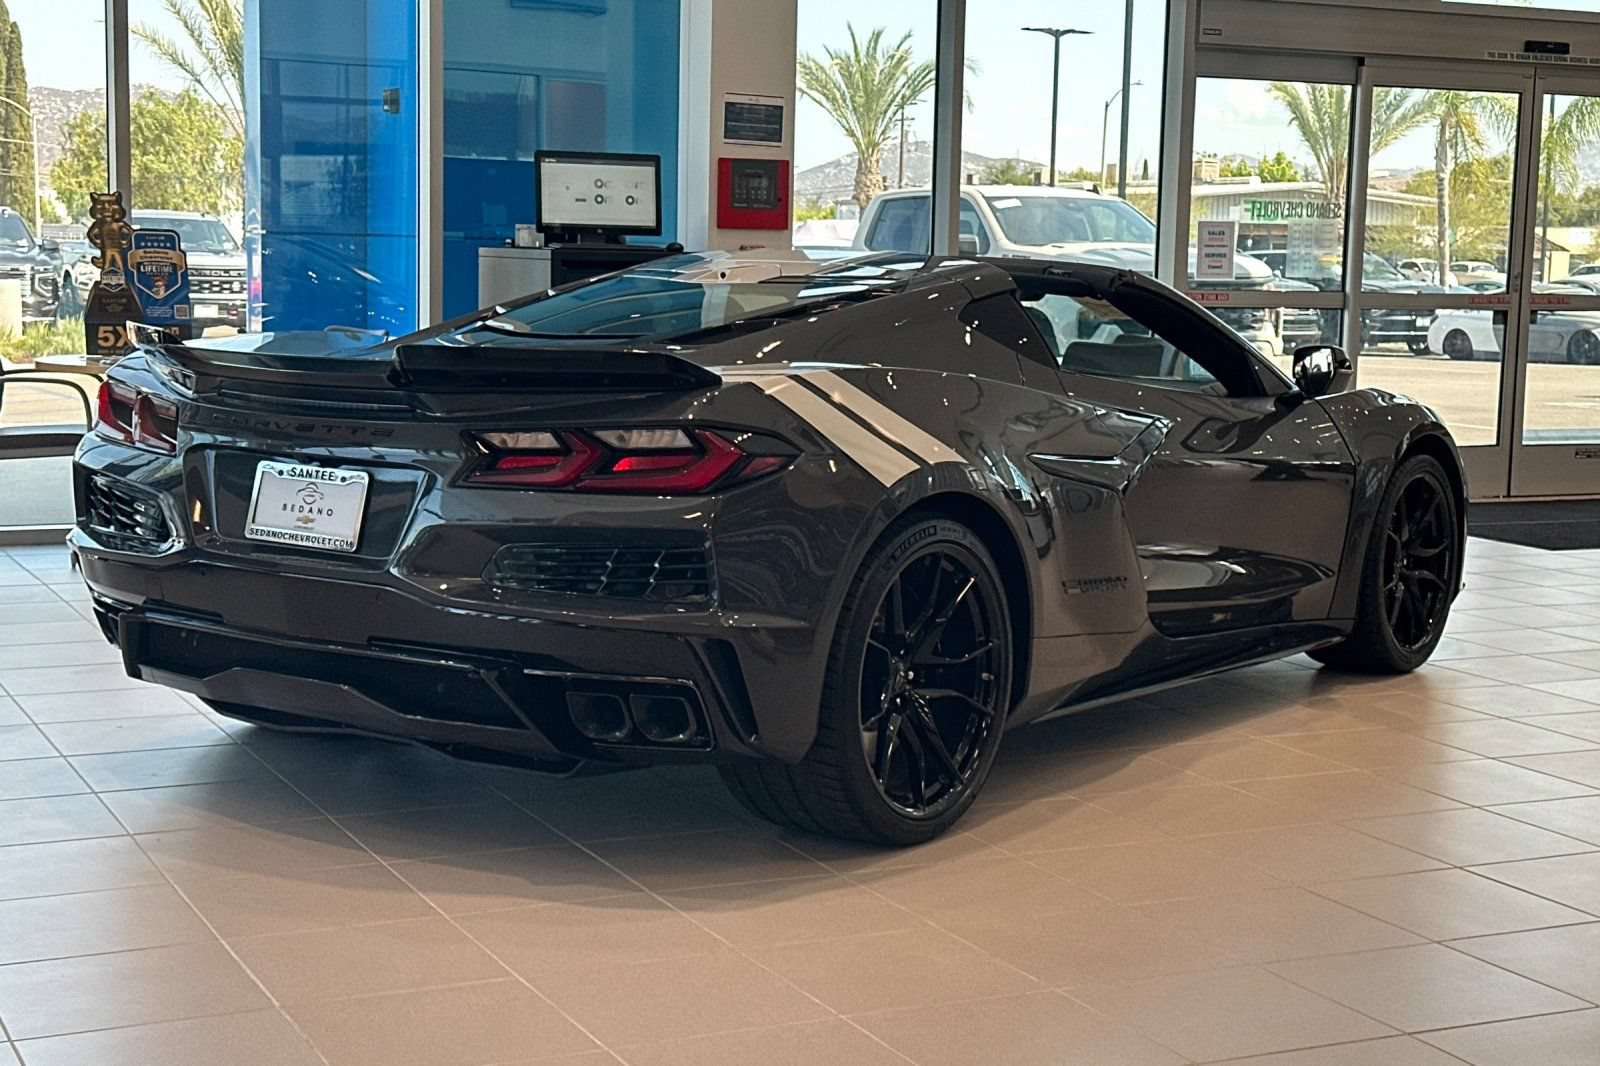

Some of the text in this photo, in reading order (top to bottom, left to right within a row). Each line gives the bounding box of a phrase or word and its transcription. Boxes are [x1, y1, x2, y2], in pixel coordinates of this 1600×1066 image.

[140, 265, 174, 273] LIFETIME
[212, 413, 396, 437] CORVETTE
[290, 467, 336, 481] SANTEE
[281, 503, 334, 517] SEDANO
[249, 527, 353, 549] SEDANOCHEVROLET.COM
[892, 525, 937, 559] MICHELIN
